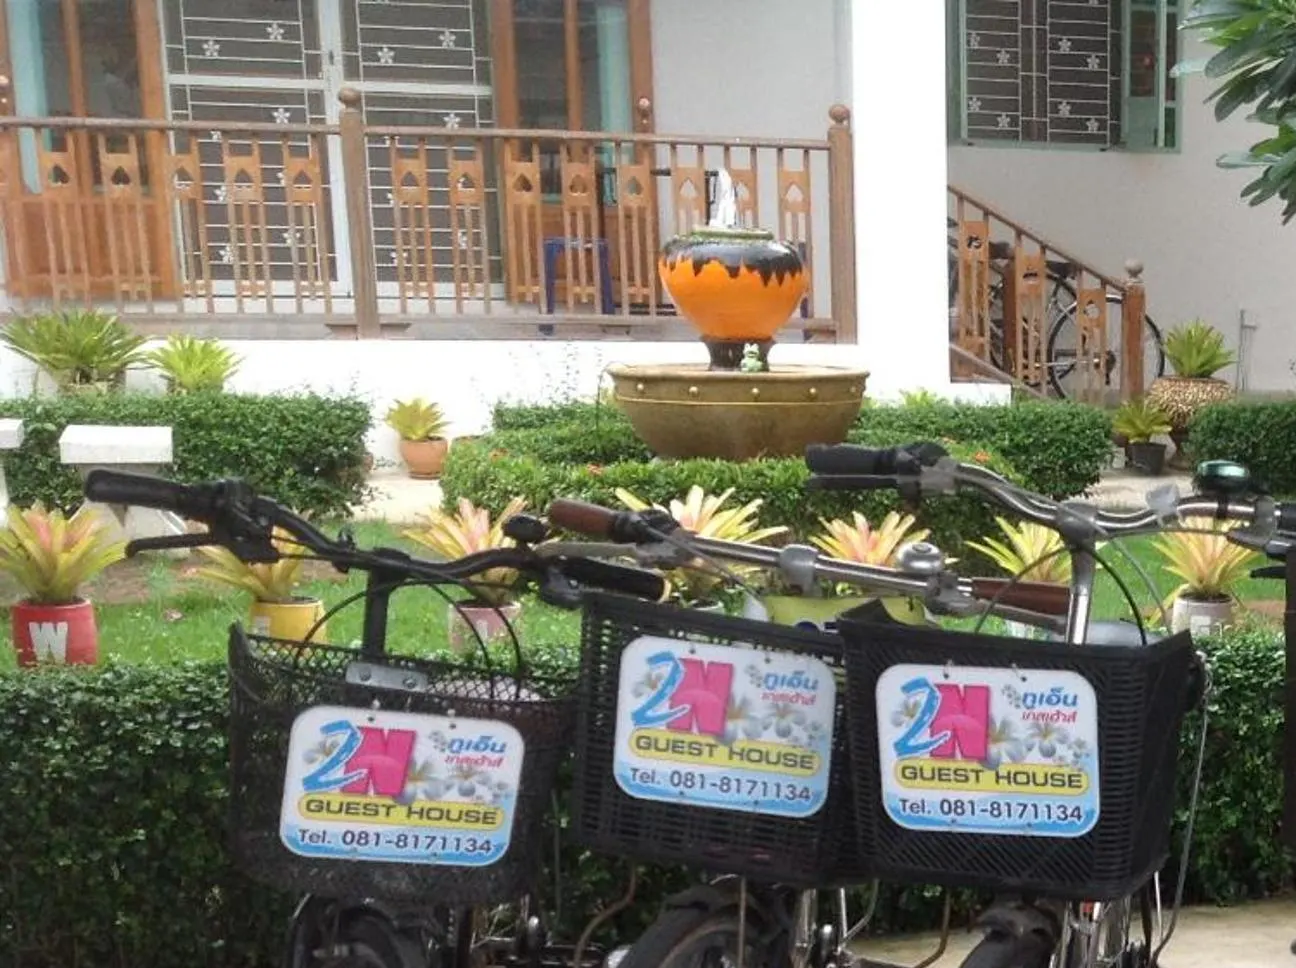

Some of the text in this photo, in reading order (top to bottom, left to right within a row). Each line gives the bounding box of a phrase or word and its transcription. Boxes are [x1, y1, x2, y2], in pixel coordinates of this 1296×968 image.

[631, 651, 734, 736] 2N
[893, 678, 990, 761] 2N
[302, 720, 417, 799] 2N
[635, 735, 814, 770] GUEST HOUSE
[630, 768, 811, 801] Tel. 081-8171134
[901, 765, 1083, 788] GUEST HOUSE
[306, 800, 497, 825] GUEST HOUSE
[899, 800, 1082, 821] Tel. 081-8171134
[299, 829, 492, 852] Tel. 081-8171134
